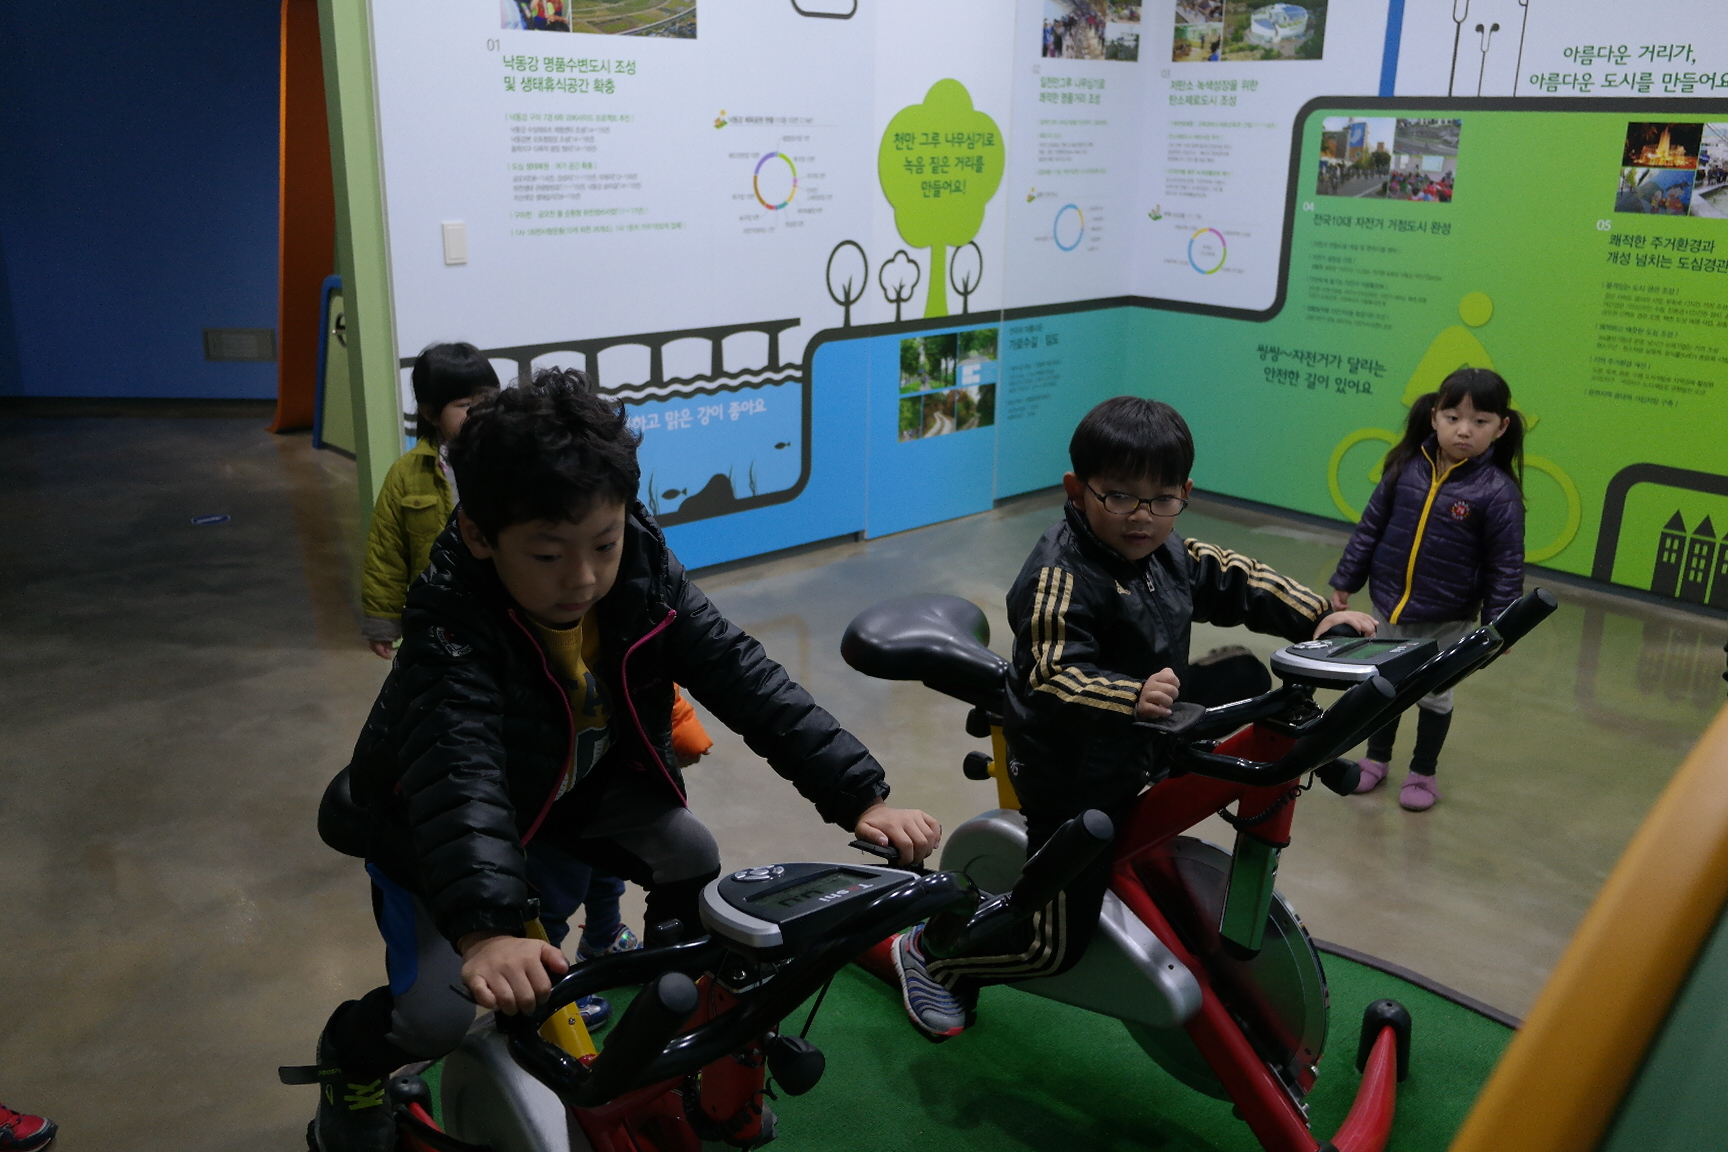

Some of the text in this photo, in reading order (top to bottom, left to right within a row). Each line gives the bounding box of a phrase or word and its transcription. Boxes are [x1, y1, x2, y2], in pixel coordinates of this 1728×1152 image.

[487, 39, 500, 51] 01
[1563, 43, 1696, 66] 아름다운 거리가,
[503, 55, 637, 75] 낙동강 명품수변도시 조성
[504, 76, 615, 94] 및 생태휴식공간 확충
[1170, 80, 1258, 92] 저탄소 녹색성장을 위한
[1529, 72, 1595, 93] 아름다운
[1601, 72, 1655, 93] 도시를
[1169, 95, 1237, 107] 탄소제로도시 조성
[893, 132, 995, 151] 천만 그루 나무심기로
[903, 155, 985, 174] 녹음 짙은 거리를
[921, 179, 967, 198] 만들어요!
[1302, 201, 1315, 211] 04
[1313, 213, 1451, 235] 전국10대 자전거 거점도시 완성
[1596, 219, 1612, 231] 05
[1608, 233, 1715, 254] 쾌적한 주거환경과
[1607, 251, 1631, 266] 개성
[1636, 253, 1673, 269] 넘치는
[1347, 357, 1387, 378] 달리는
[1264, 366, 1373, 395] 안전한 길이 있어요
[627, 398, 767, 431] 하고 맑은 강이 좋아요
[818, 883, 874, 902] Toshi
